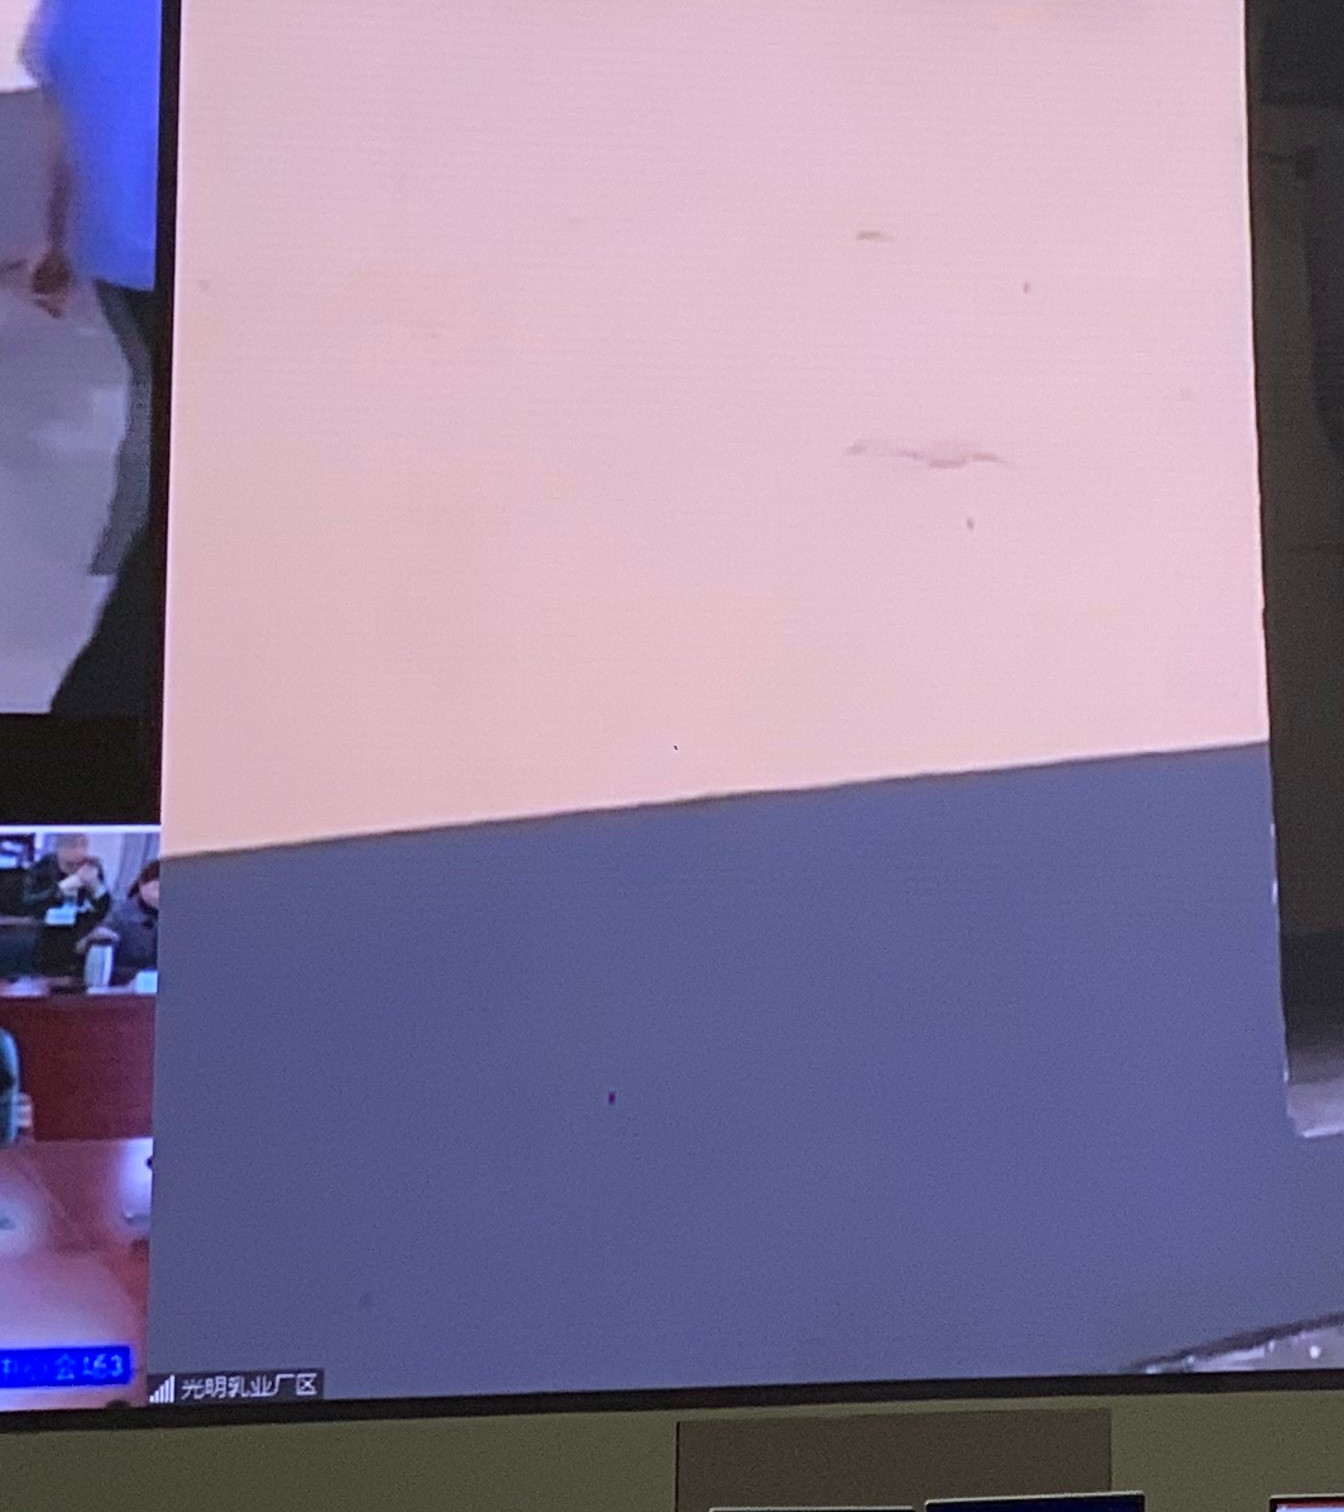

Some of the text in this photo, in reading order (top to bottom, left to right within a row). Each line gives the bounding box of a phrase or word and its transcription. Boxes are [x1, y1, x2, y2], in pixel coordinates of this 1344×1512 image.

[180, 1373, 318, 1400] 光明乳业厂区
